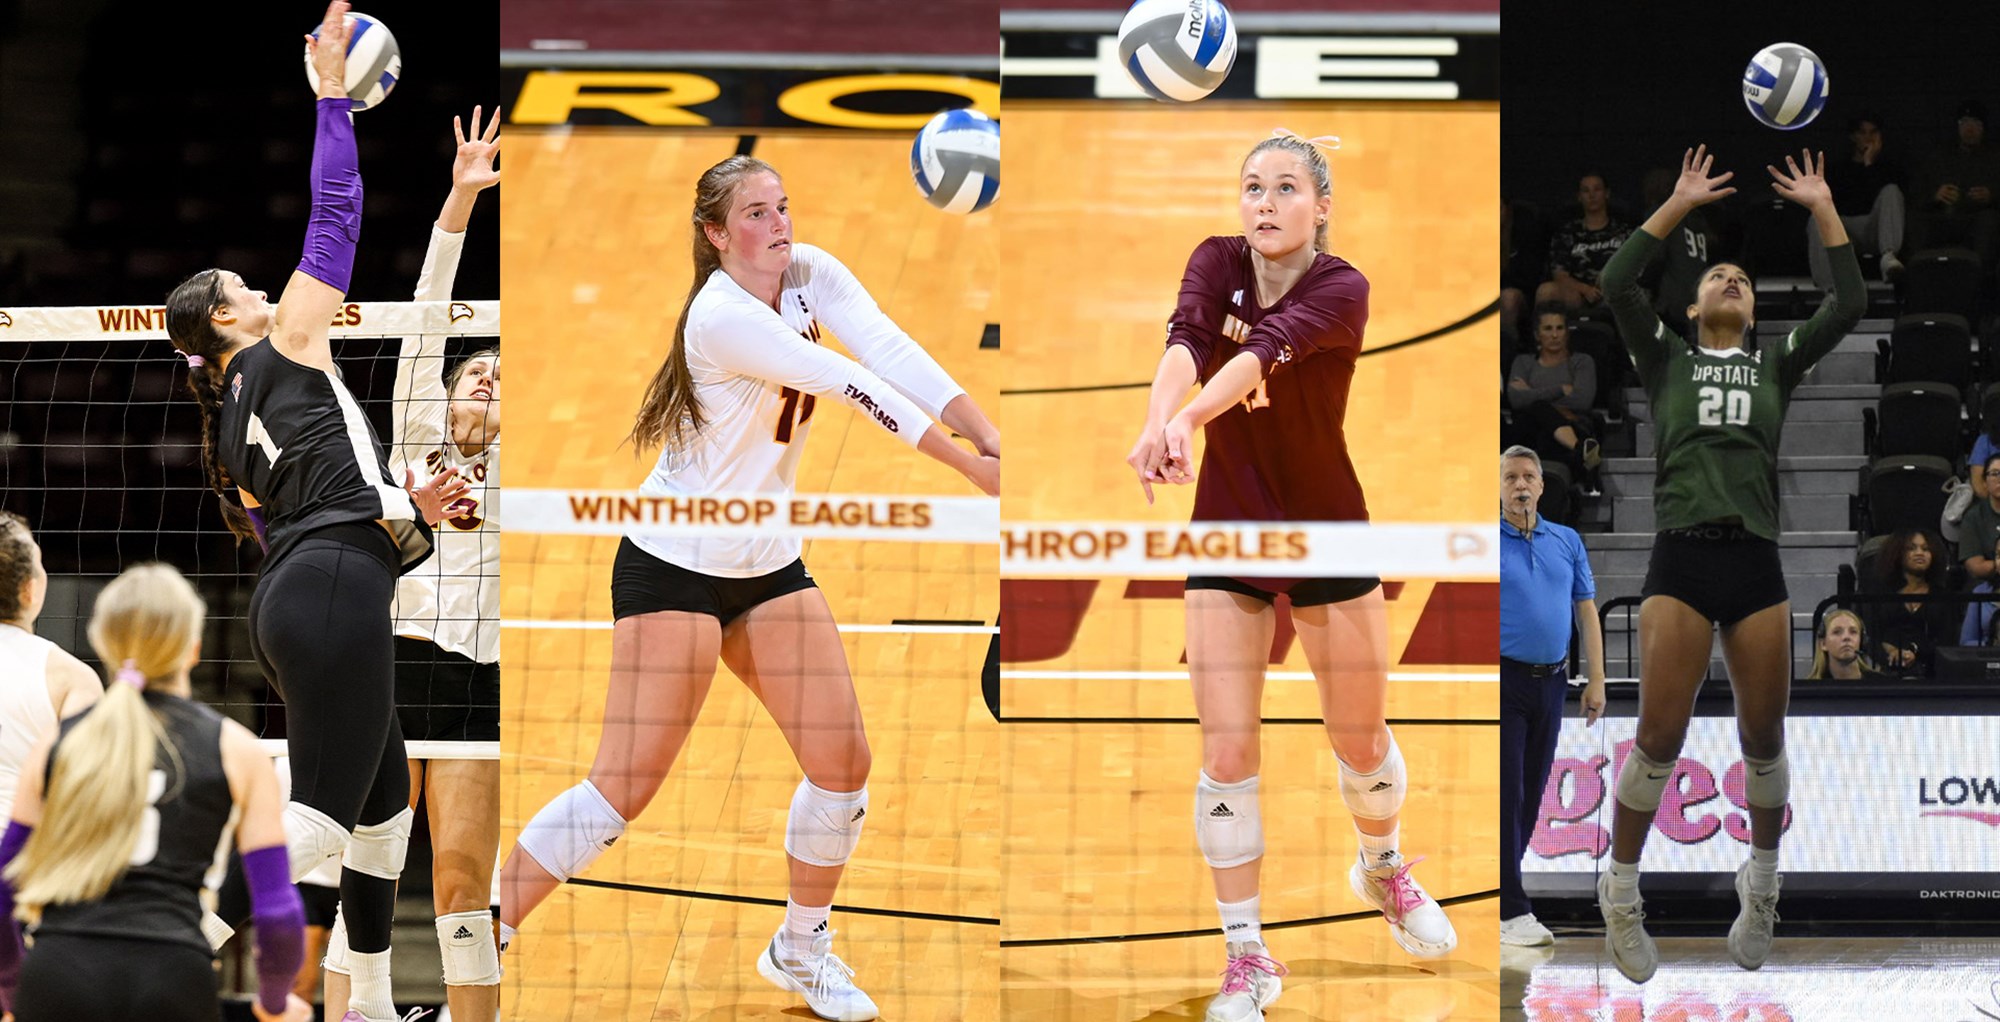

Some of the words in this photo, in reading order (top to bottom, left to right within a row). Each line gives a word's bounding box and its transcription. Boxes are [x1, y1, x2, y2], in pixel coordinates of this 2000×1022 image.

[1684, 227, 1707, 262] 99
[98, 308, 167, 331] WINT
[1692, 364, 1759, 387] UPSTATE
[1698, 386, 1751, 426] 20
[246, 411, 283, 470] 1
[570, 496, 776, 525] WINTHROP
[788, 501, 932, 529] EAGLES
[1000, 529, 1128, 560] HROP
[1144, 530, 1309, 561] EAGLES
[1919, 777, 2000, 805] LOW
